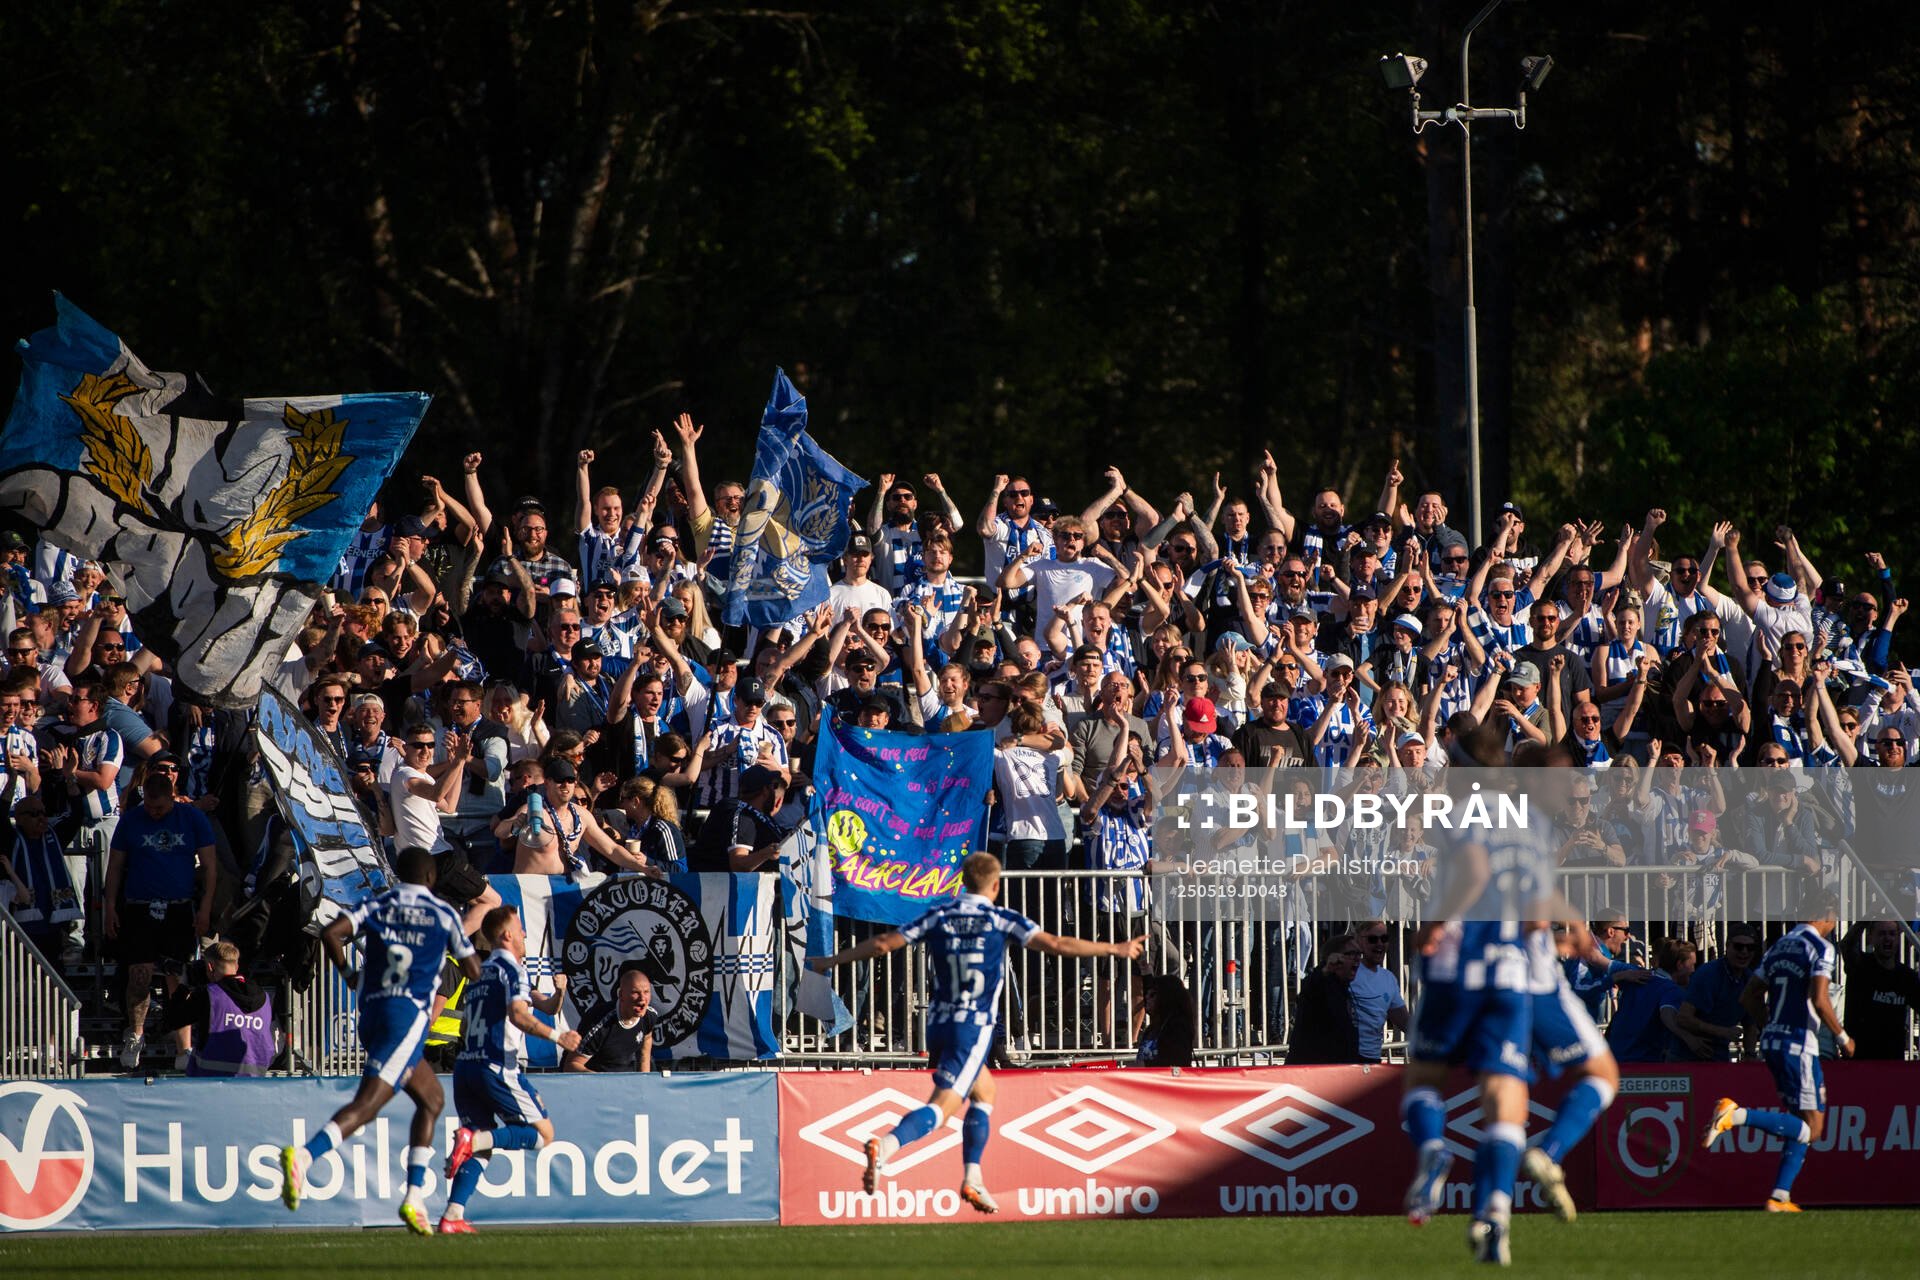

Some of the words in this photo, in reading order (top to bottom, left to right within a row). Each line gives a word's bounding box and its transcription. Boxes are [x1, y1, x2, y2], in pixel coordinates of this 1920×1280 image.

[752, 682, 760, 693] P
[904, 744, 930, 762] red
[381, 943, 414, 990] 8
[946, 952, 985, 1003] 15
[1773, 976, 1790, 1024] 7
[224, 1013, 264, 1030] FOTO
[463, 998, 489, 1052] 14
[1617, 1079, 1687, 1092] EGERFORS
[818, 1180, 961, 1219] umbro
[1017, 1177, 1160, 1216] umbro
[1218, 1175, 1359, 1213] umbro
